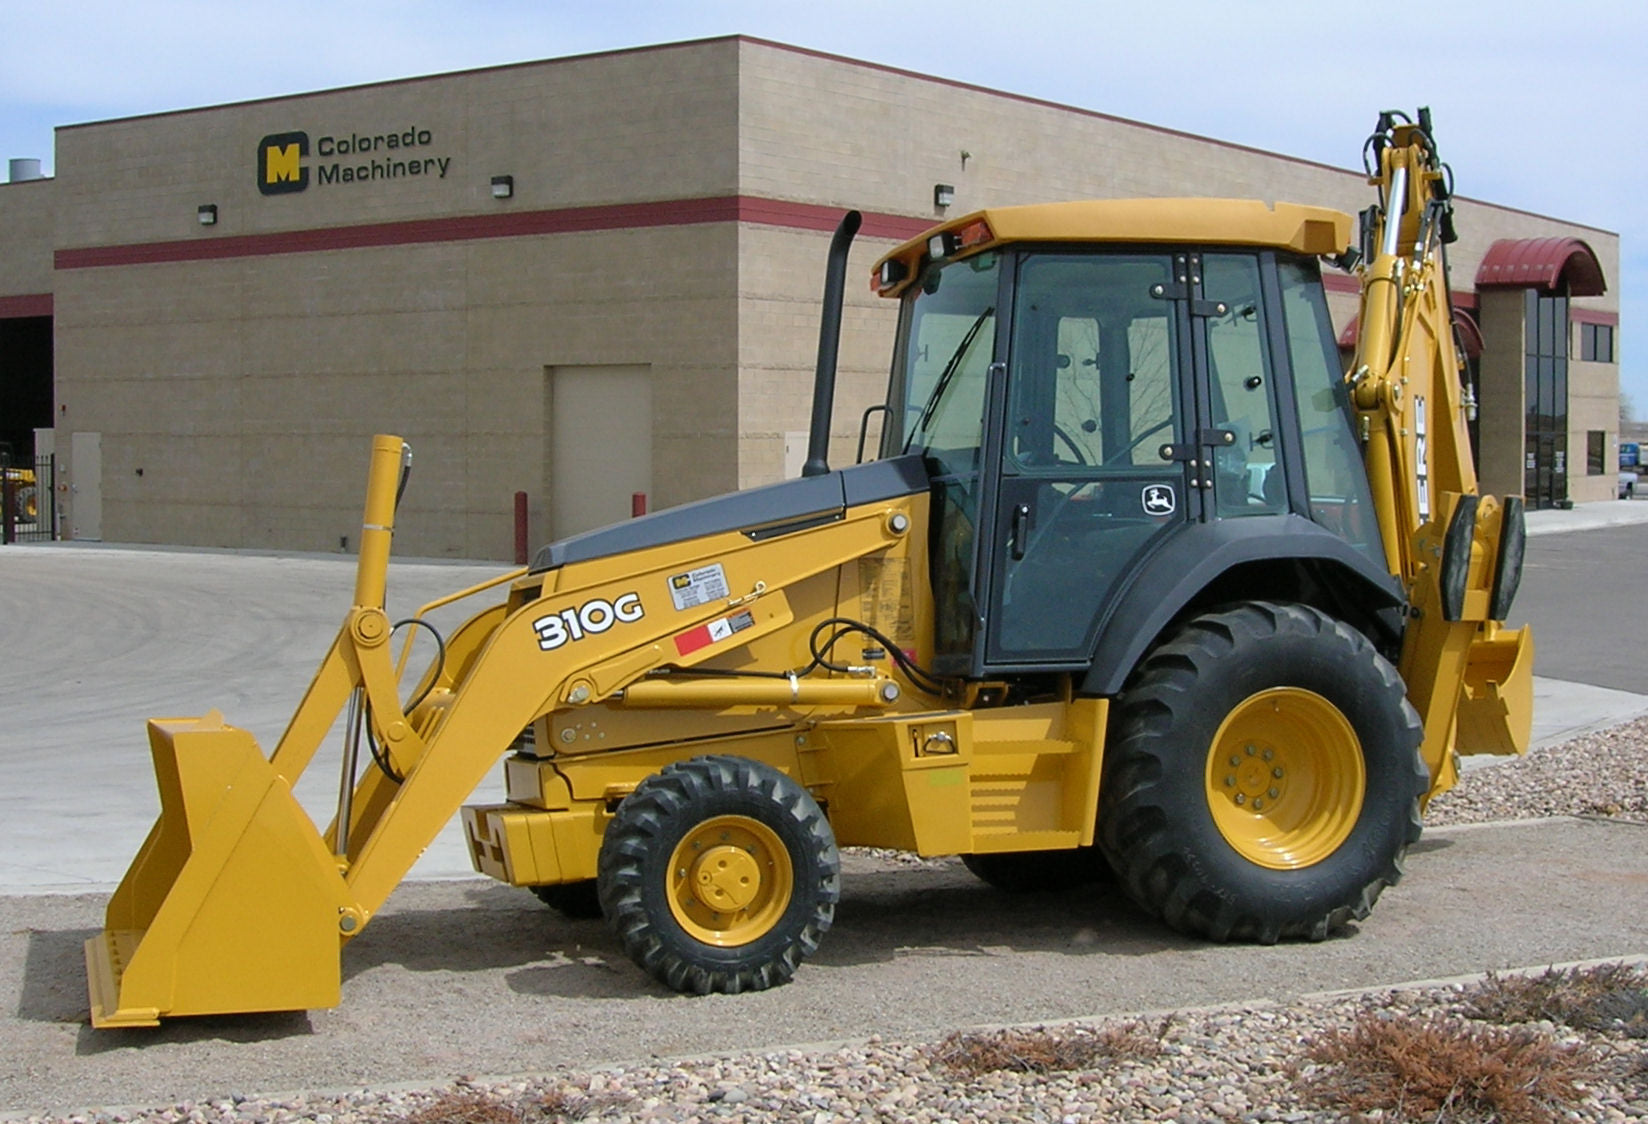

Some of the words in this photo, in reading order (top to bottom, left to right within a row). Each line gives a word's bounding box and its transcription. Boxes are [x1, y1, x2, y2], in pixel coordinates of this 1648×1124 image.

[318, 126, 432, 156] Colorado
[318, 157, 451, 185] Machinery
[1414, 394, 1430, 526] ERE
[532, 591, 645, 651] 310G
